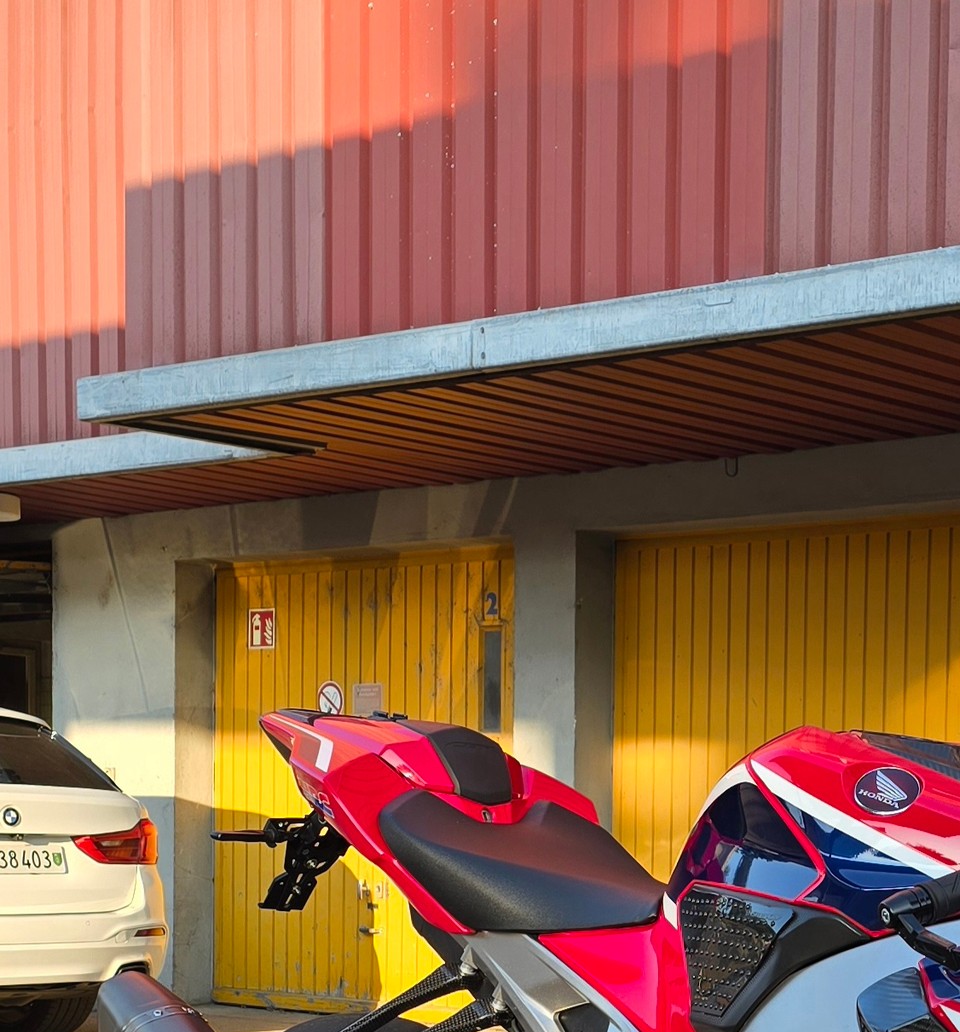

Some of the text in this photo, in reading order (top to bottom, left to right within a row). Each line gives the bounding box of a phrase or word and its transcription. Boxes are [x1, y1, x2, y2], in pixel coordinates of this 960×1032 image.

[486, 592, 498, 615] 2
[858, 789, 899, 808] HONDA
[0, 850, 52, 869] 38403
